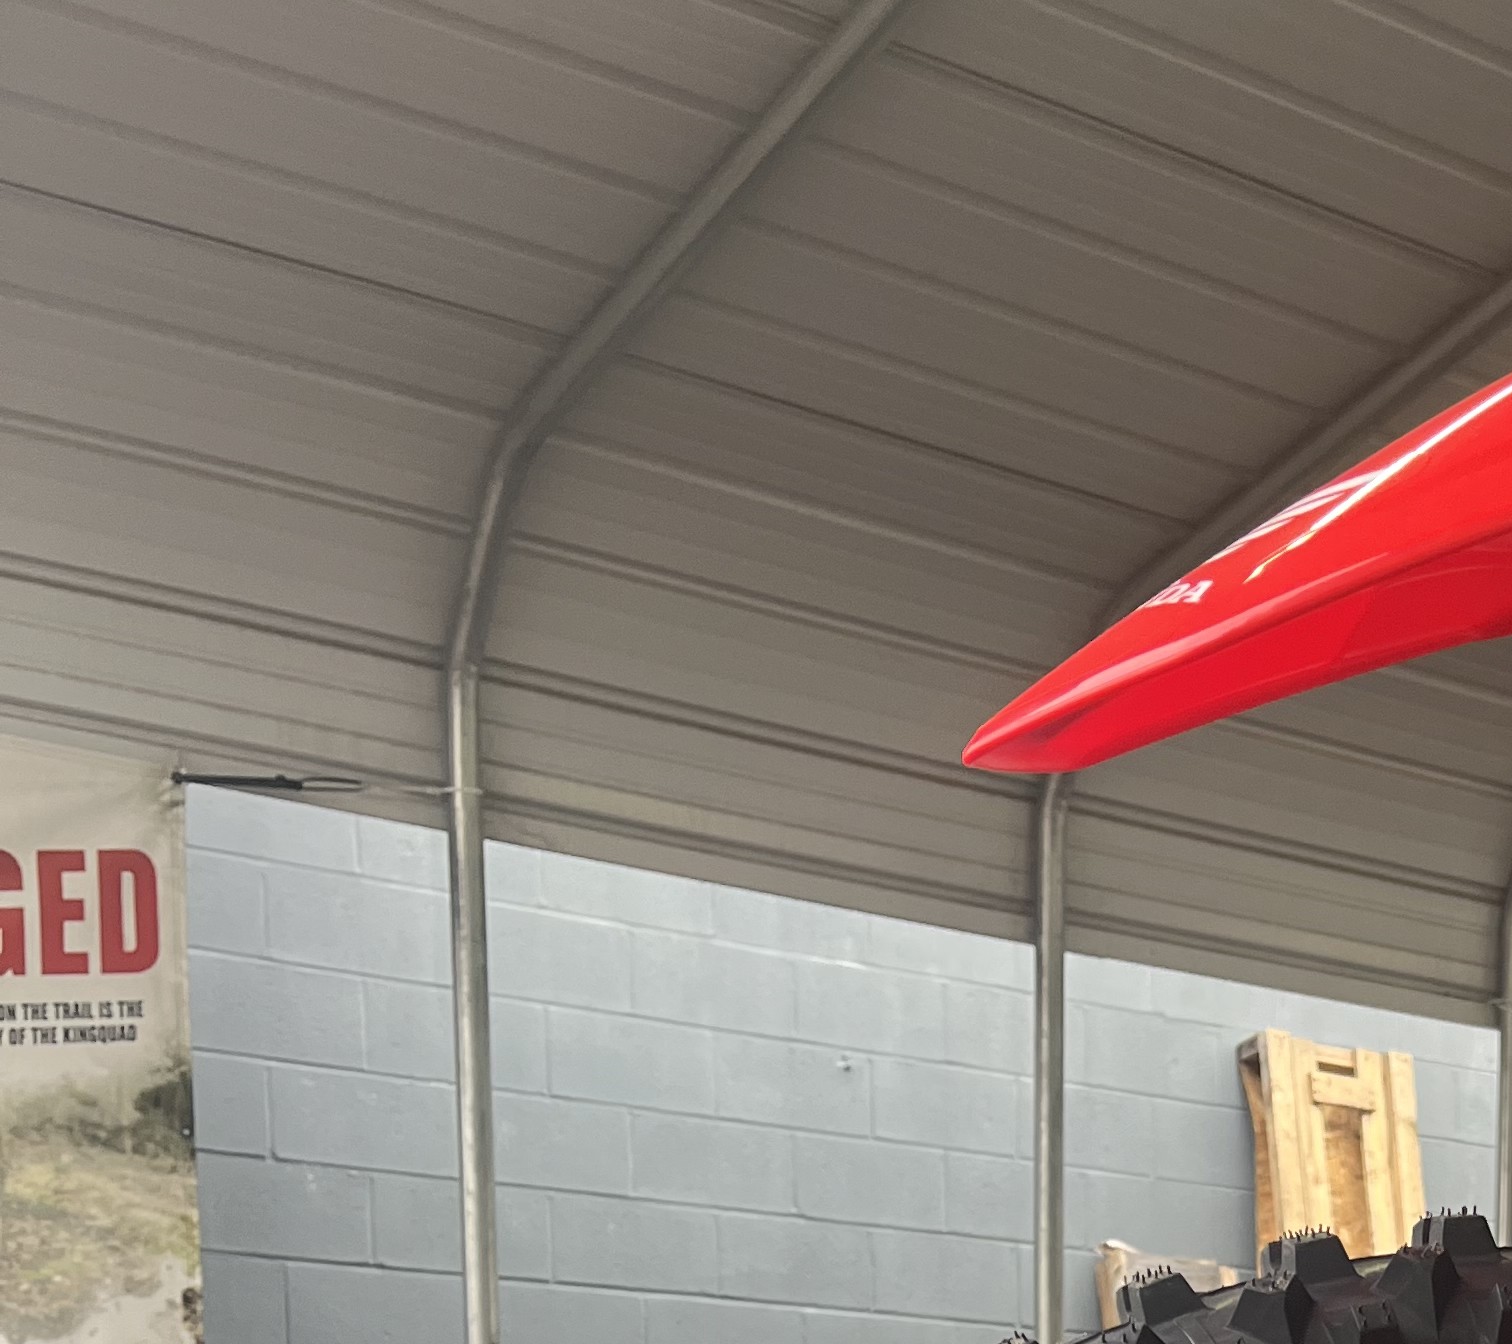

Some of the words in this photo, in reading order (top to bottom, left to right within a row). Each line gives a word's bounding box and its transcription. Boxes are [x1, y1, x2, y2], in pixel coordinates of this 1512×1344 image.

[21, 1002, 48, 1020] THE
[53, 1001, 94, 1019] TRAIL
[98, 1001, 113, 1018] IS
[117, 1000, 144, 1018] THE
[8, 1026, 25, 1045] OF
[30, 1025, 57, 1044] THE
[62, 1024, 138, 1043] KINGQUAD
